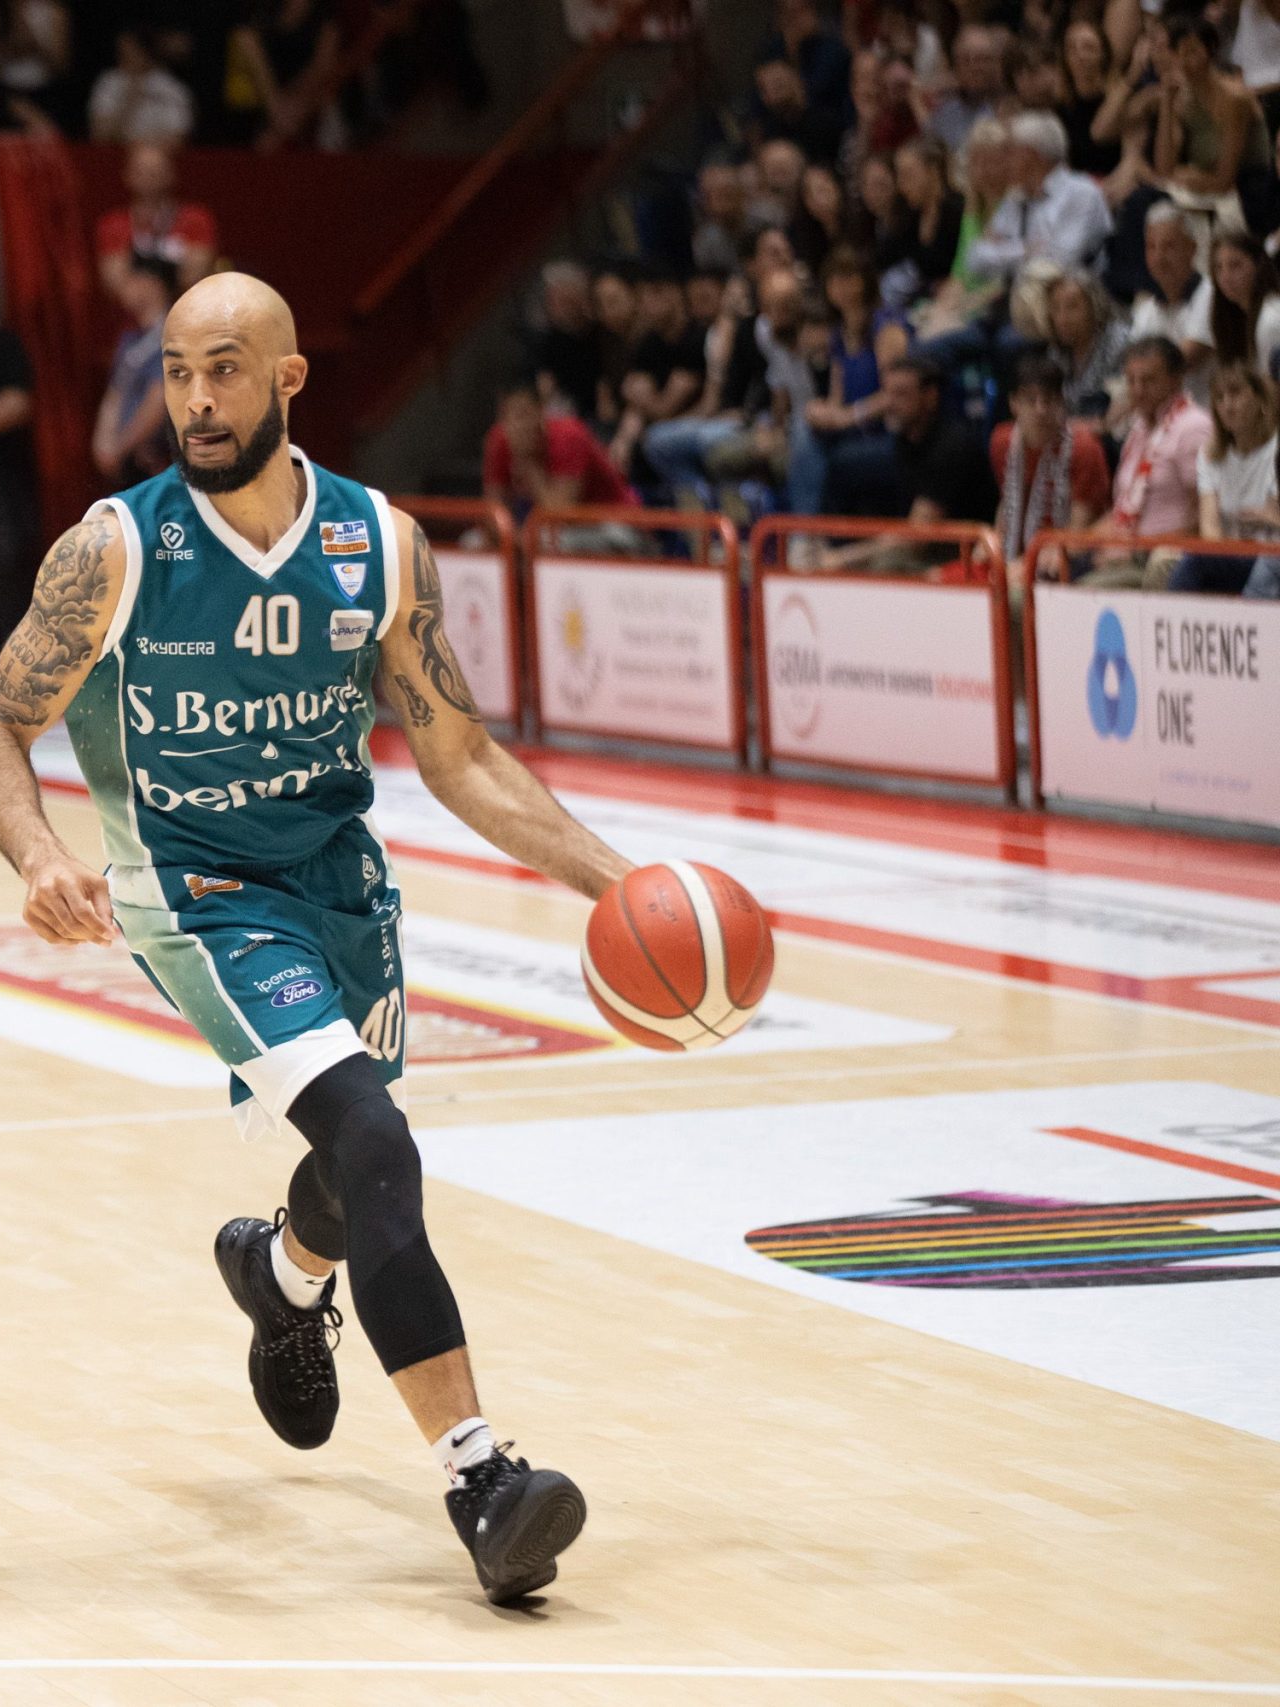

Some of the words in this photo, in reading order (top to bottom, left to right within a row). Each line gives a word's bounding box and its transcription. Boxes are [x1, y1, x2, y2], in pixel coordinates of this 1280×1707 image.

[156, 549, 194, 561] BITRE
[234, 594, 300, 656] 40
[149, 641, 216, 656] KYOCERA
[1154, 617, 1260, 681] FLORENCE
[1156, 688, 1196, 746] ONE
[253, 963, 313, 993] iperauto
[283, 982, 317, 1003] Ford
[360, 987, 404, 1062] 40
